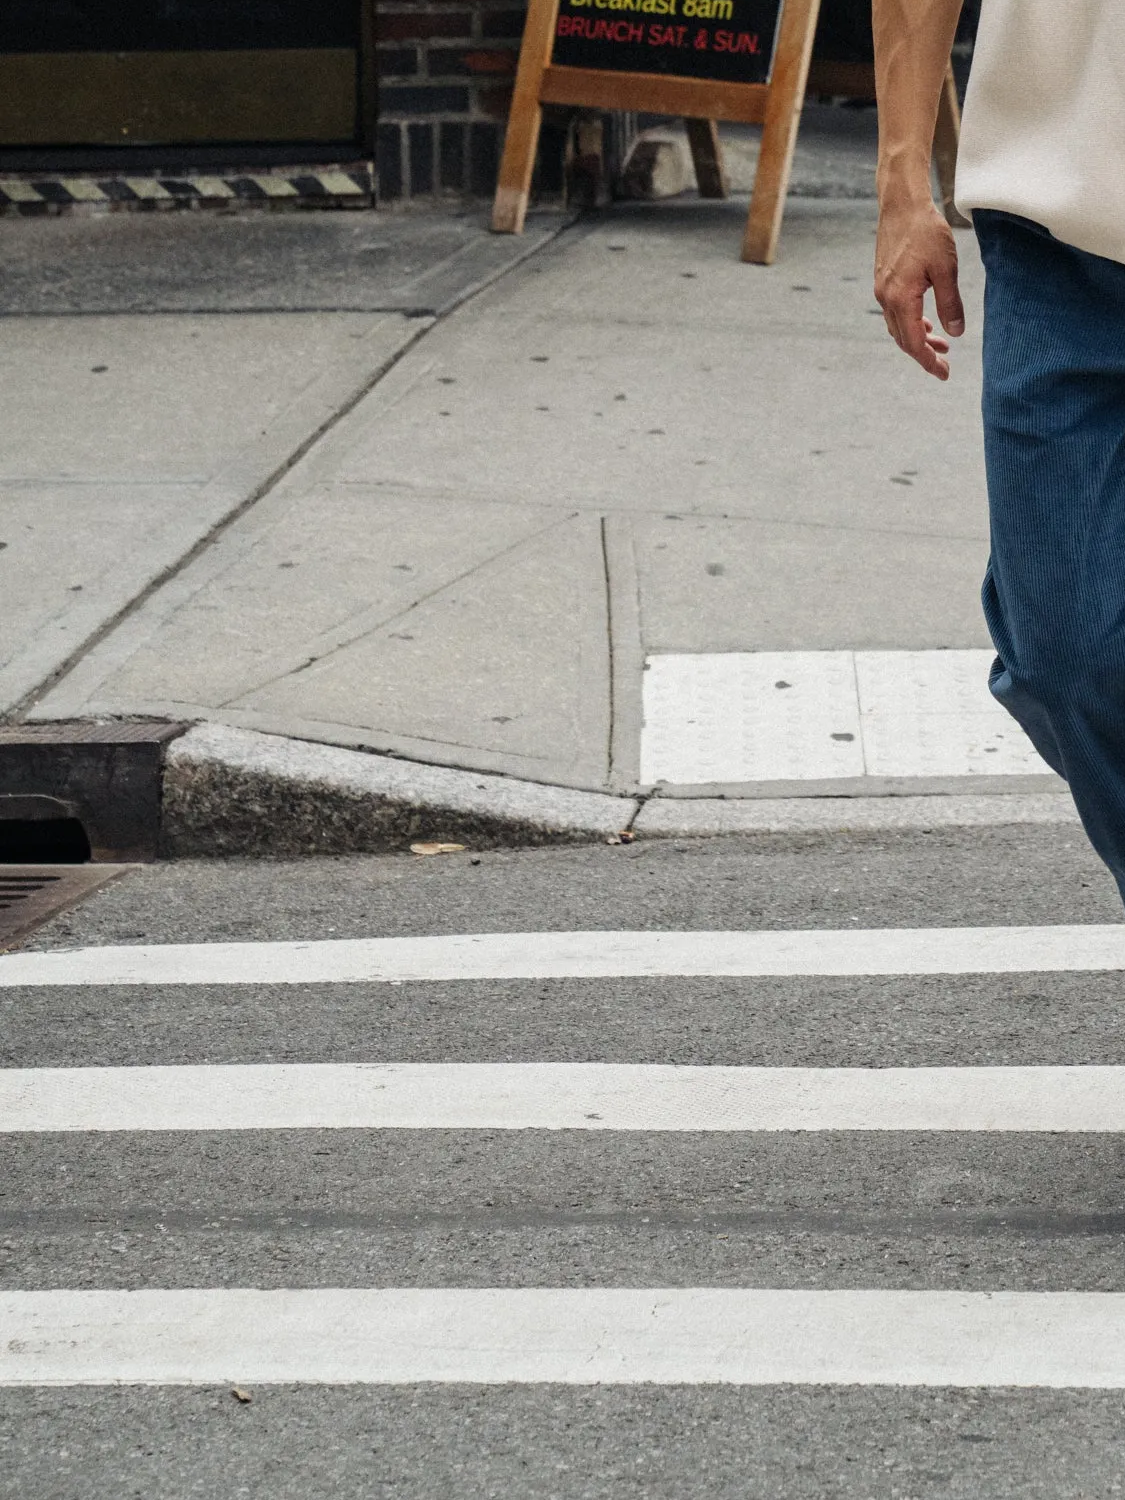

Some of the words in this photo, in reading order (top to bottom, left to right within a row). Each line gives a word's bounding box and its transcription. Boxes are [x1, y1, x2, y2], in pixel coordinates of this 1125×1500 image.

[557, 15, 645, 43] BRUNCH
[648, 23, 689, 46] SAT.
[694, 28, 709, 49] &
[714, 30, 761, 55] SUN.
